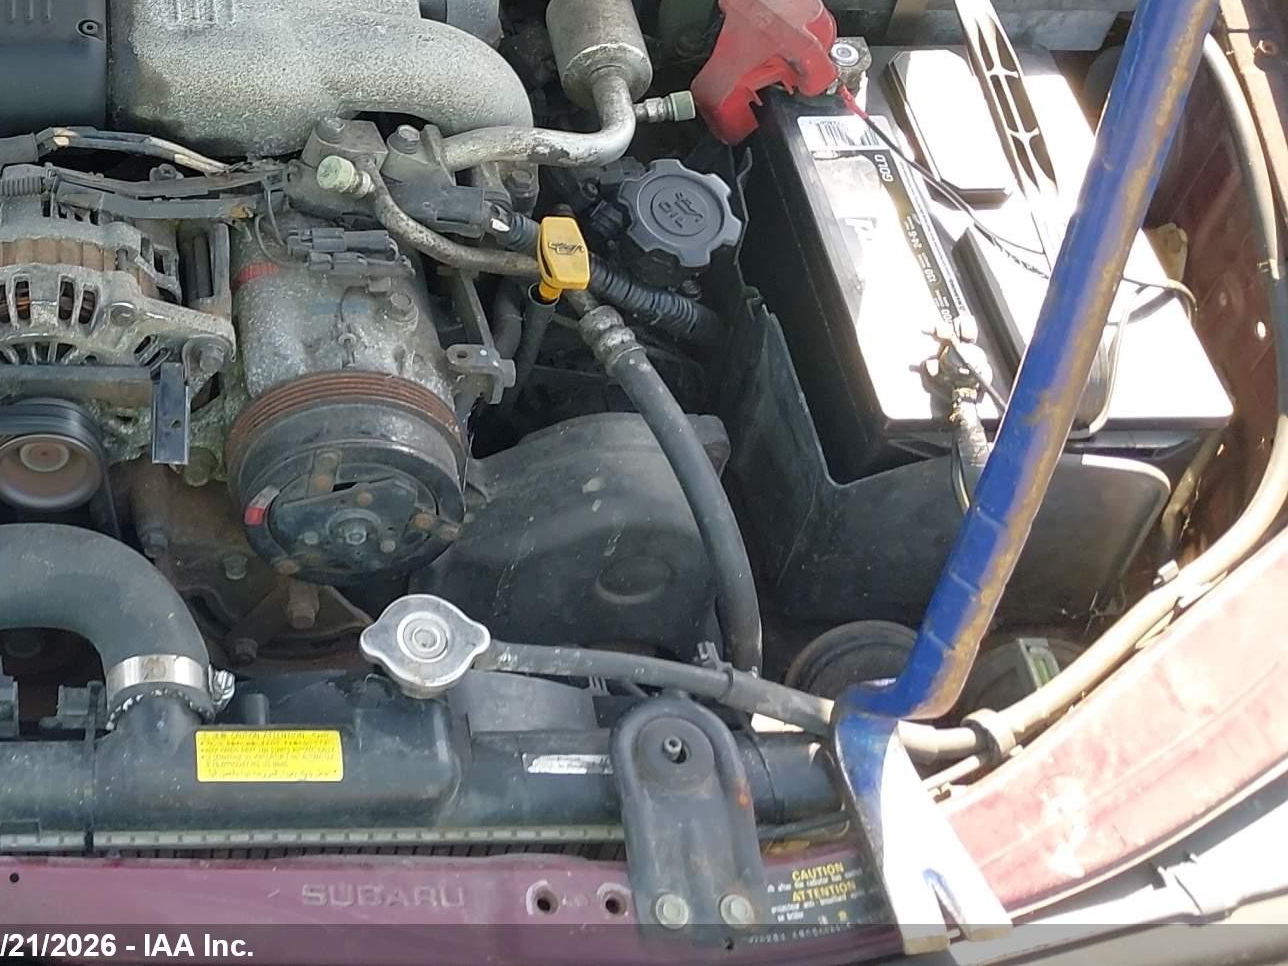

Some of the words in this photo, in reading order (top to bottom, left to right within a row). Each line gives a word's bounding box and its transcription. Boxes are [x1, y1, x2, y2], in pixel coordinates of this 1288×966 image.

[874, 154, 894, 183] GOLD
[658, 201, 684, 229] OIL
[791, 862, 845, 881] CAUTION
[301, 883, 465, 907] SUBARU
[792, 880, 857, 903] ATTENTION
